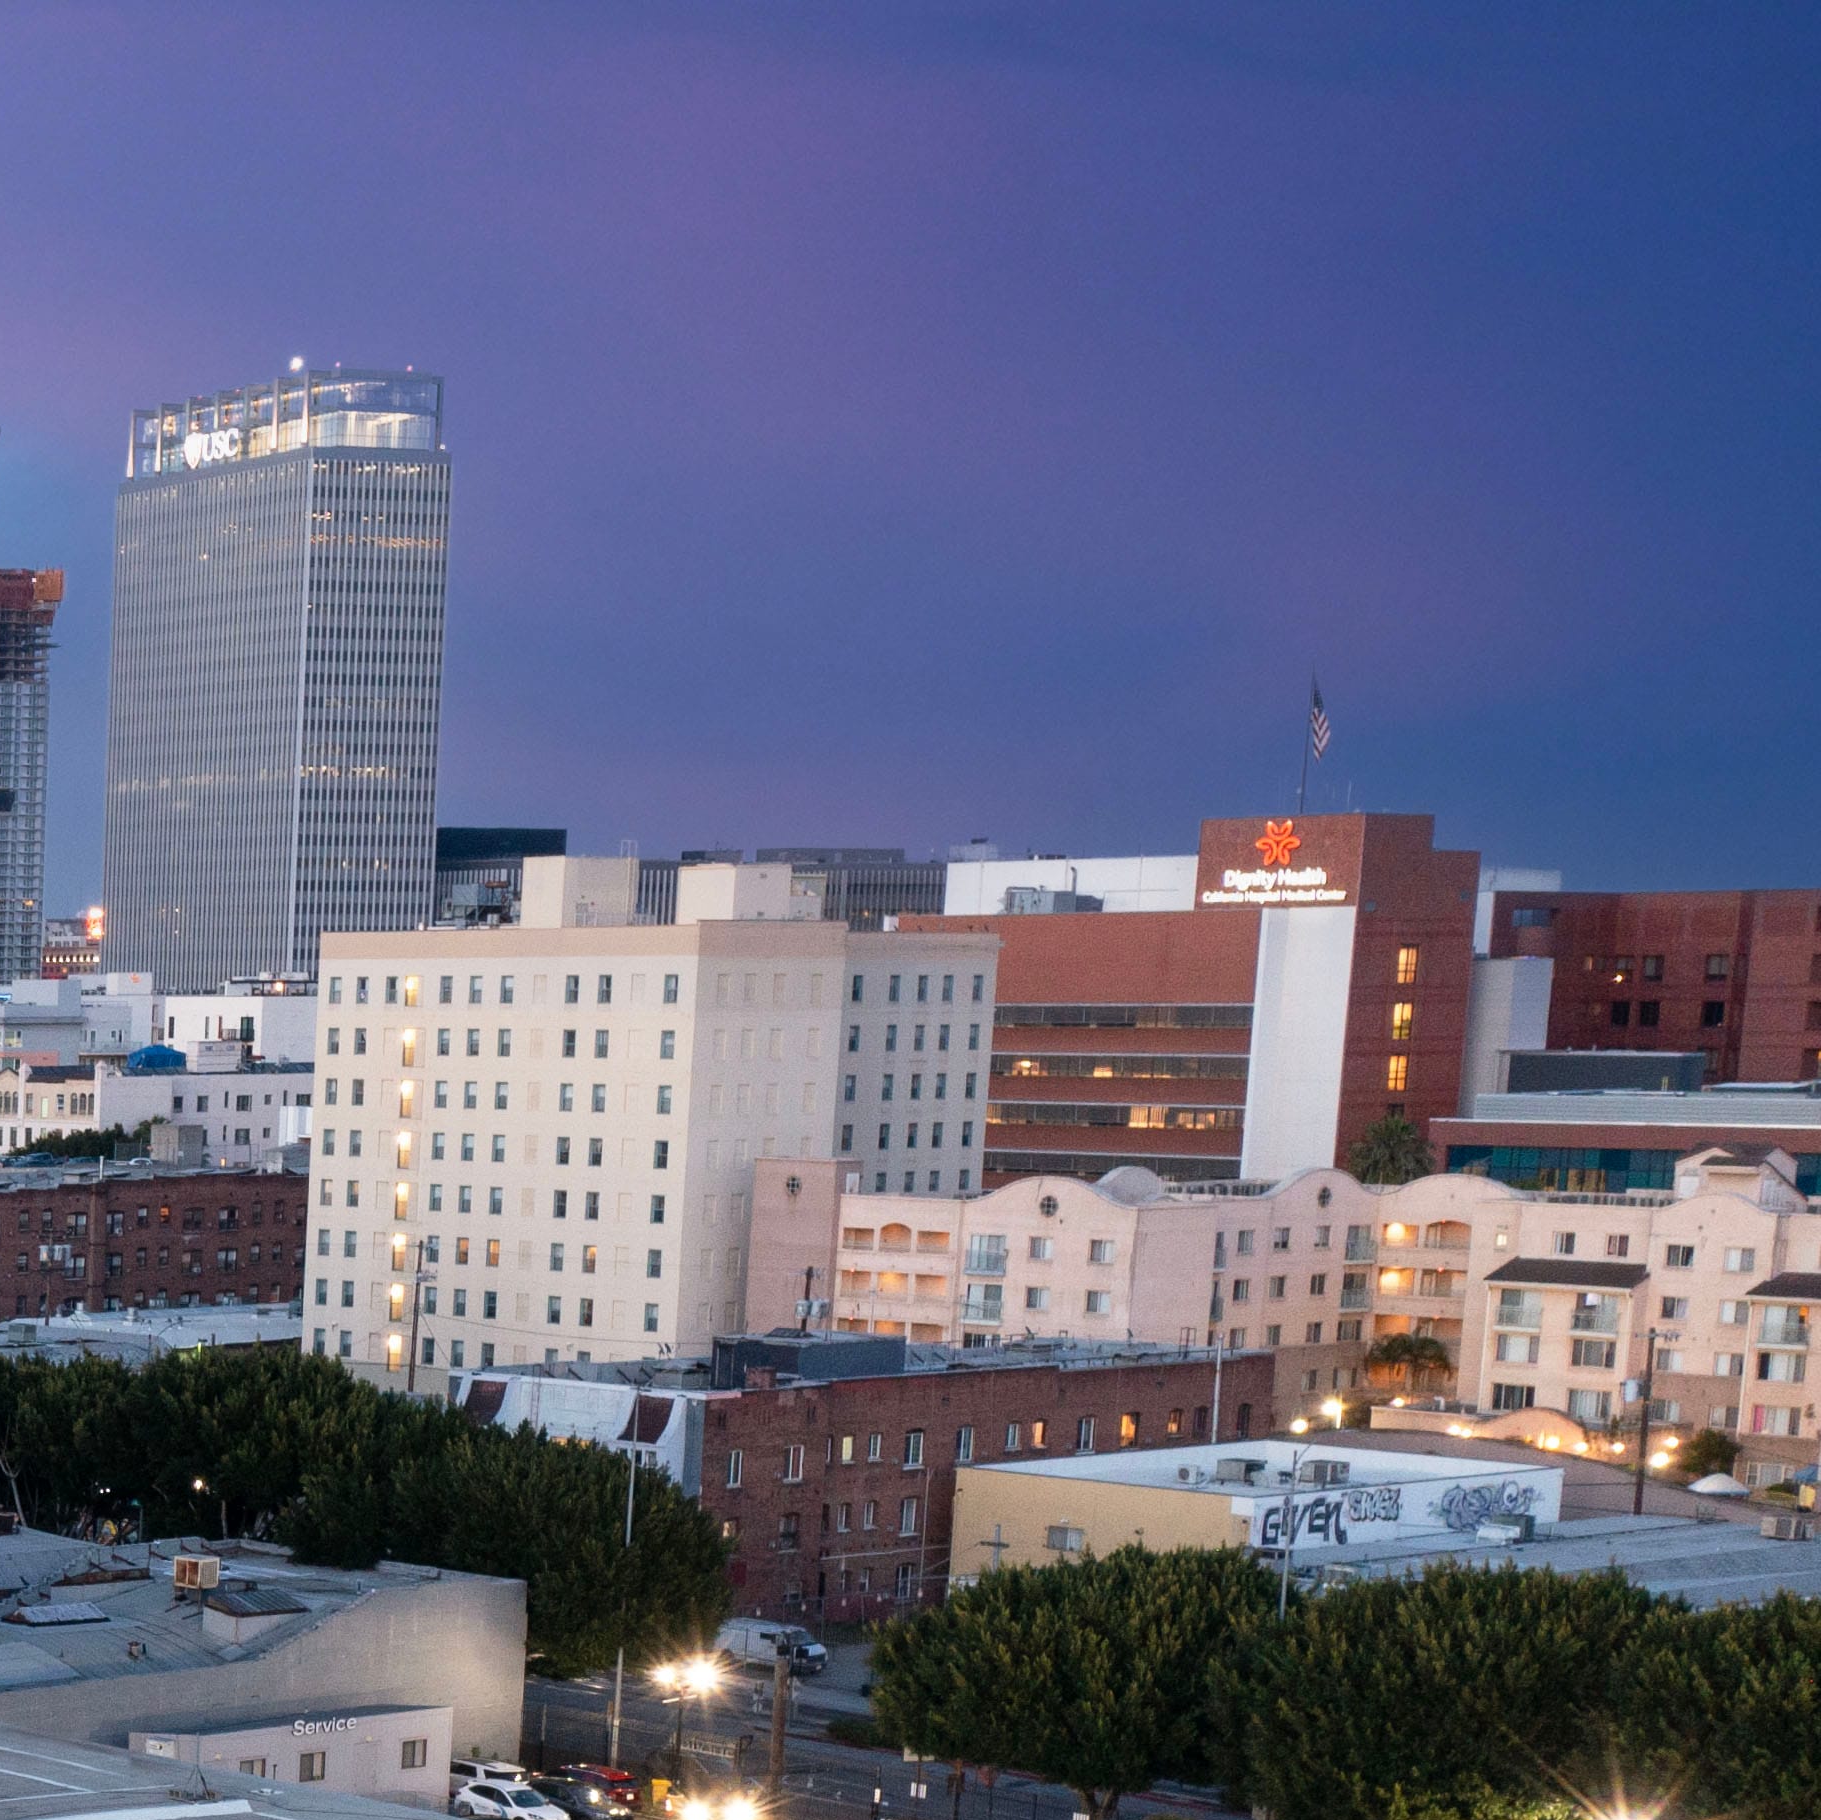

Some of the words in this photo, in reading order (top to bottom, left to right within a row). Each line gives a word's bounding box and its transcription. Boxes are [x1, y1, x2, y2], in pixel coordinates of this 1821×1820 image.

[203, 428, 239, 461] USC
[1223, 868, 1277, 891] Dignity
[1277, 866, 1327, 885] Health
[292, 1716, 357, 1737] Service
